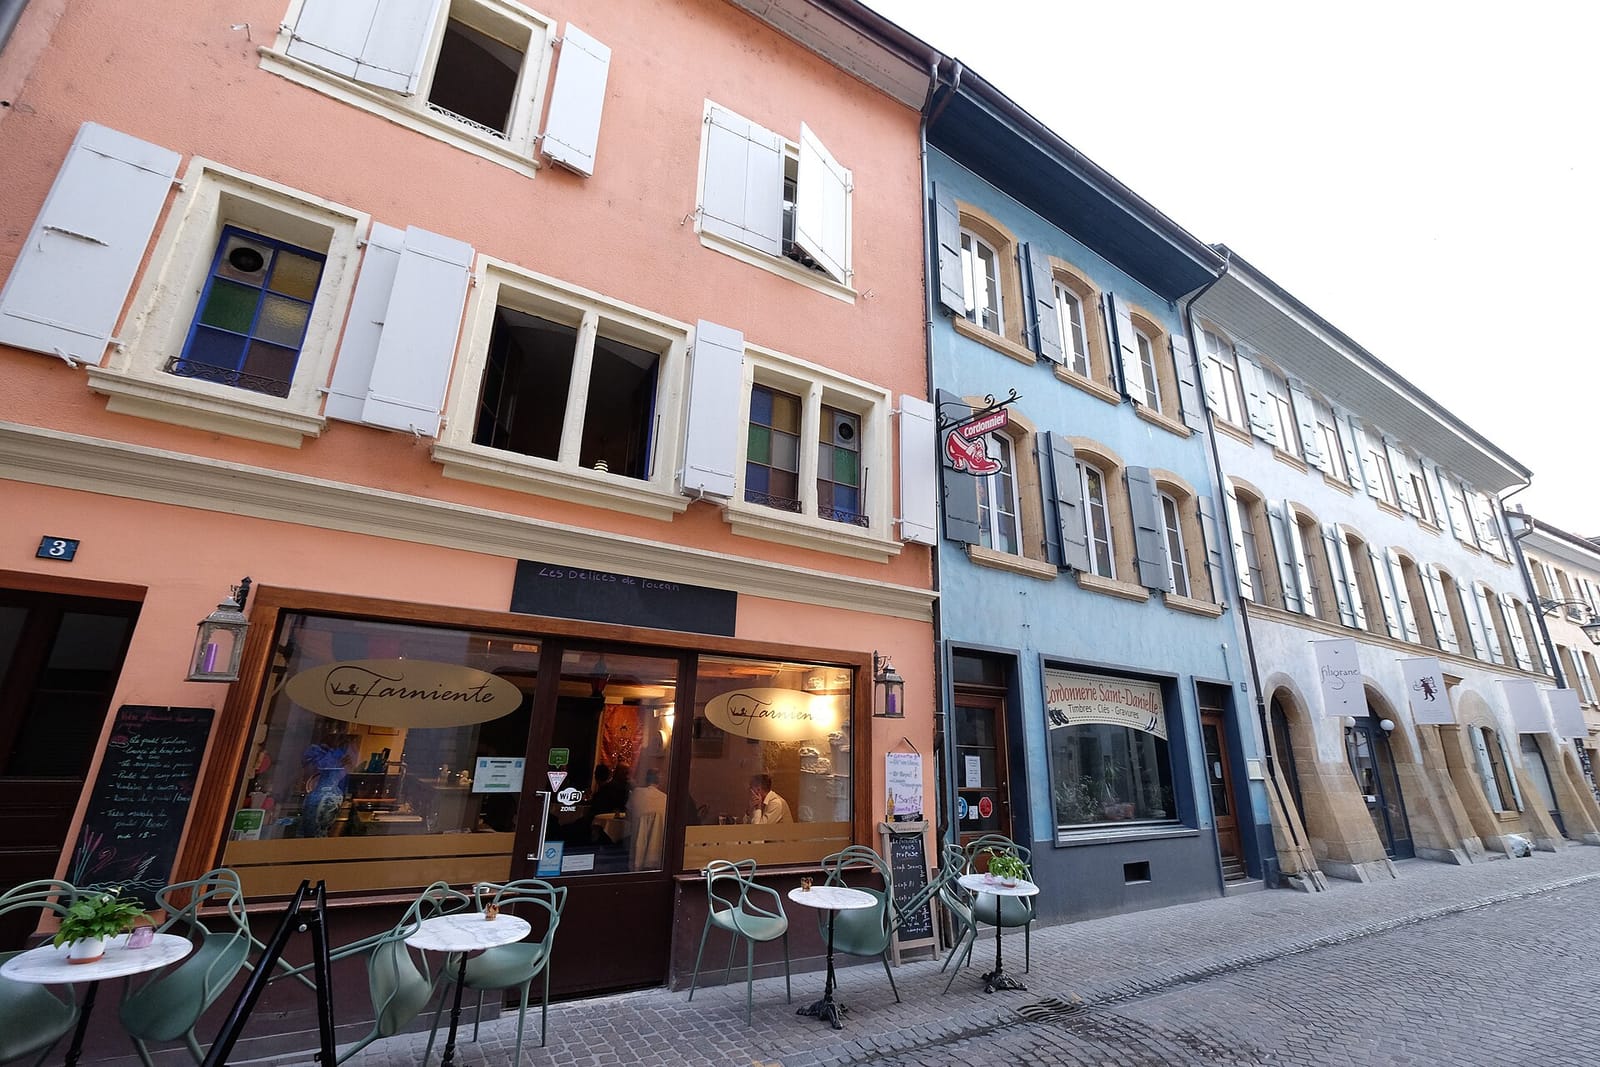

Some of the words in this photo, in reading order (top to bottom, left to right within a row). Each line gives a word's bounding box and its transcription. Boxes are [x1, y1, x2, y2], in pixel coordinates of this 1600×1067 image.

[964, 414, 1005, 437] Cordonnier
[49, 540, 67, 556] 3
[1098, 683, 1159, 715] Saint-Danielle
[1067, 703, 1092, 714] Timbres
[1114, 706, 1140, 719] Gravures
